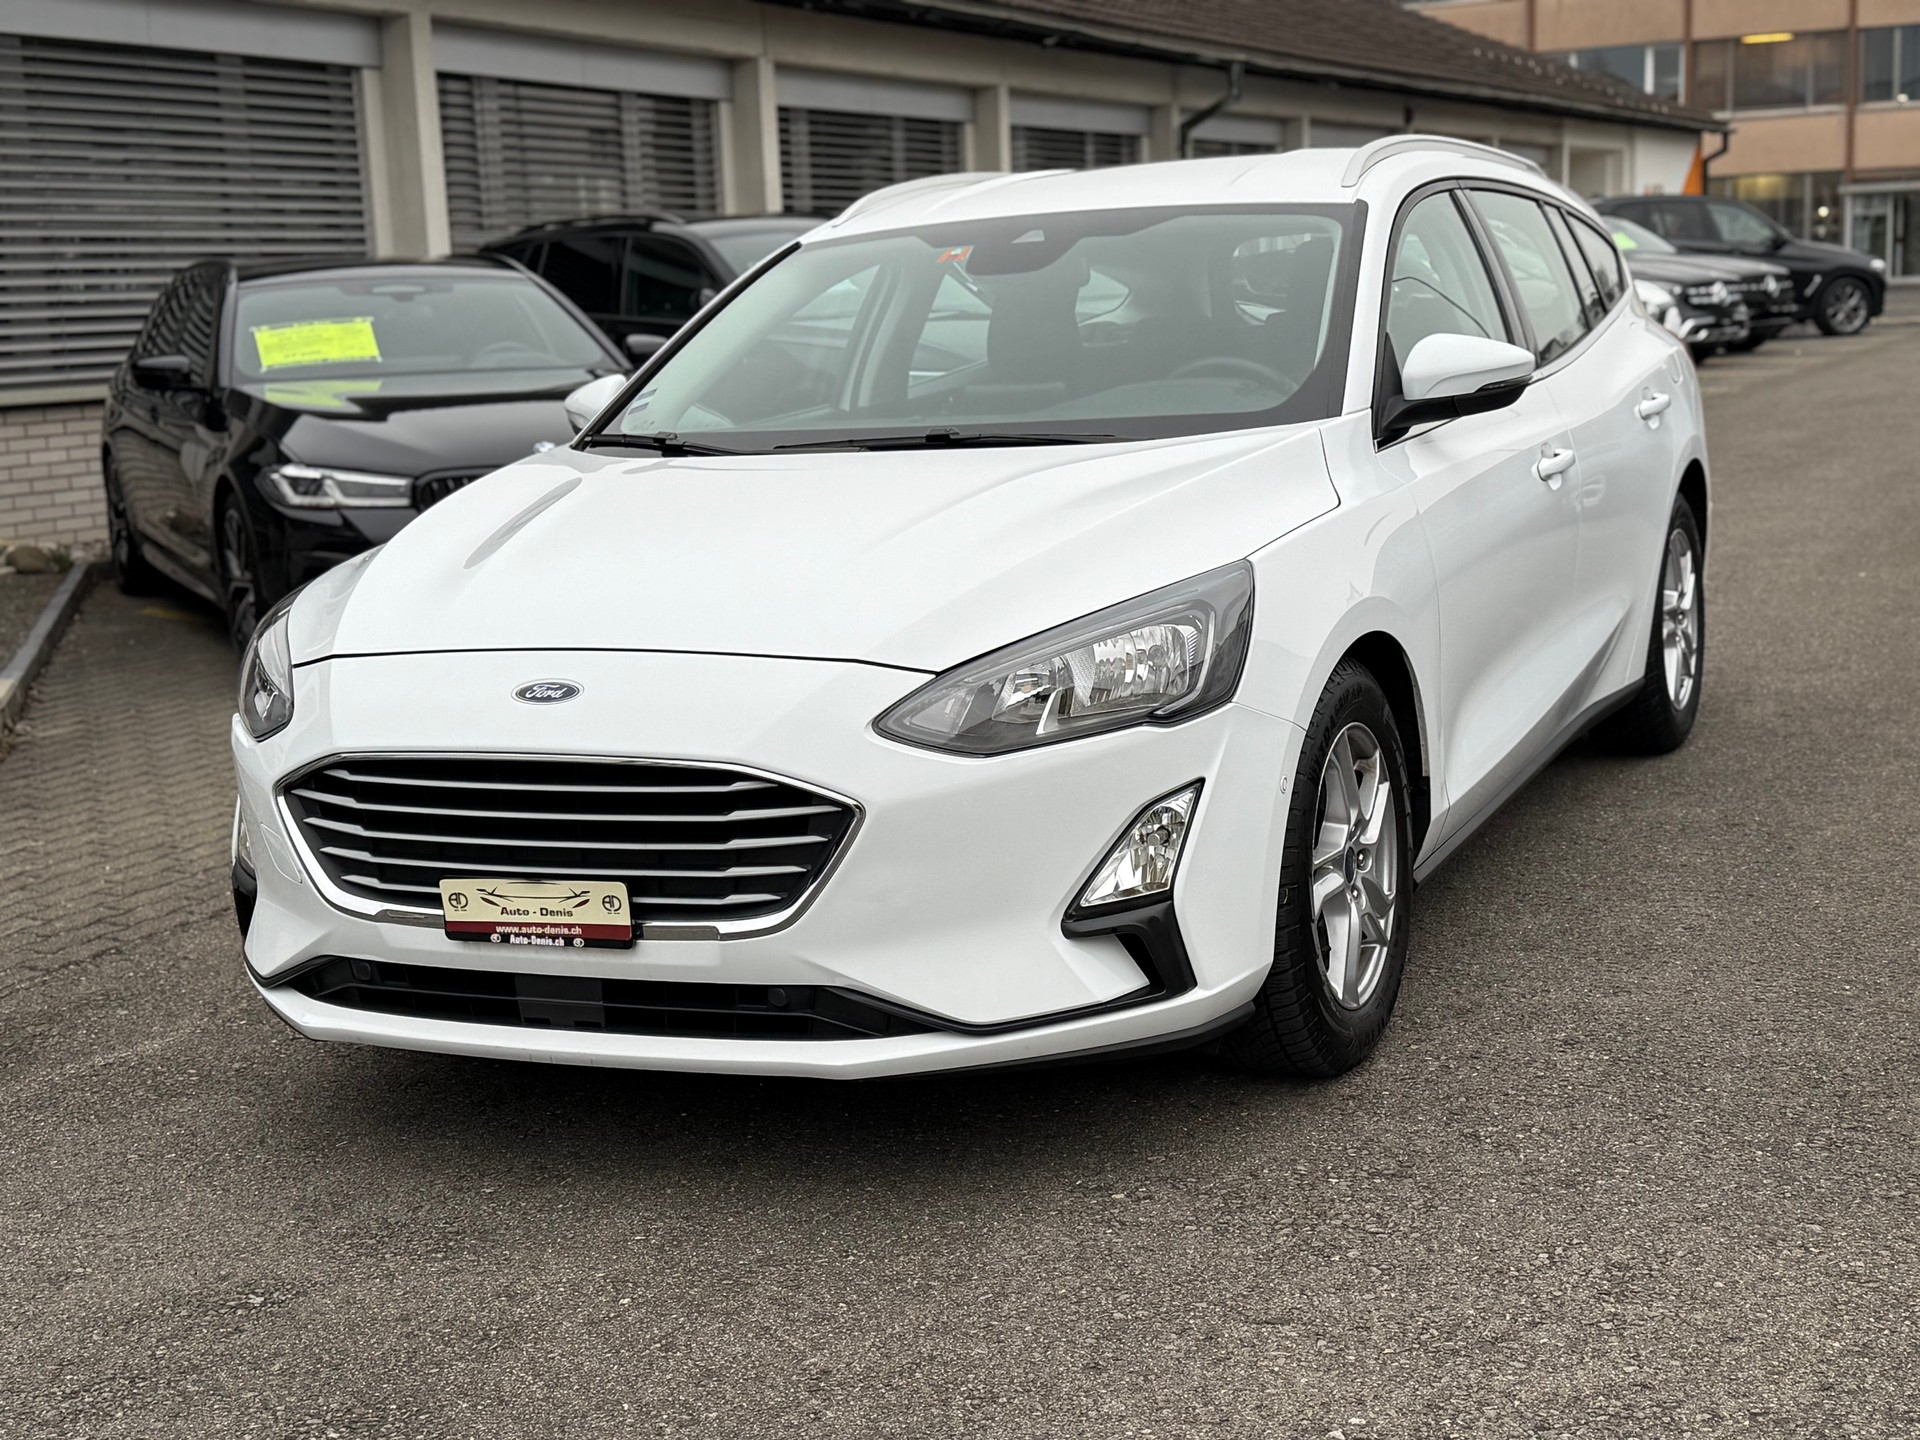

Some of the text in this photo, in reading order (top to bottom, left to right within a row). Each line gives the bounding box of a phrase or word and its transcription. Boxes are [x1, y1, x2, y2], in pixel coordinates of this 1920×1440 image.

[525, 684, 568, 698] Ford
[500, 907, 530, 917] Auto
[540, 907, 574, 918] Denis
[495, 925, 582, 935] www.auto-denis.ch
[510, 934, 565, 947] Auto-Denis.ch
